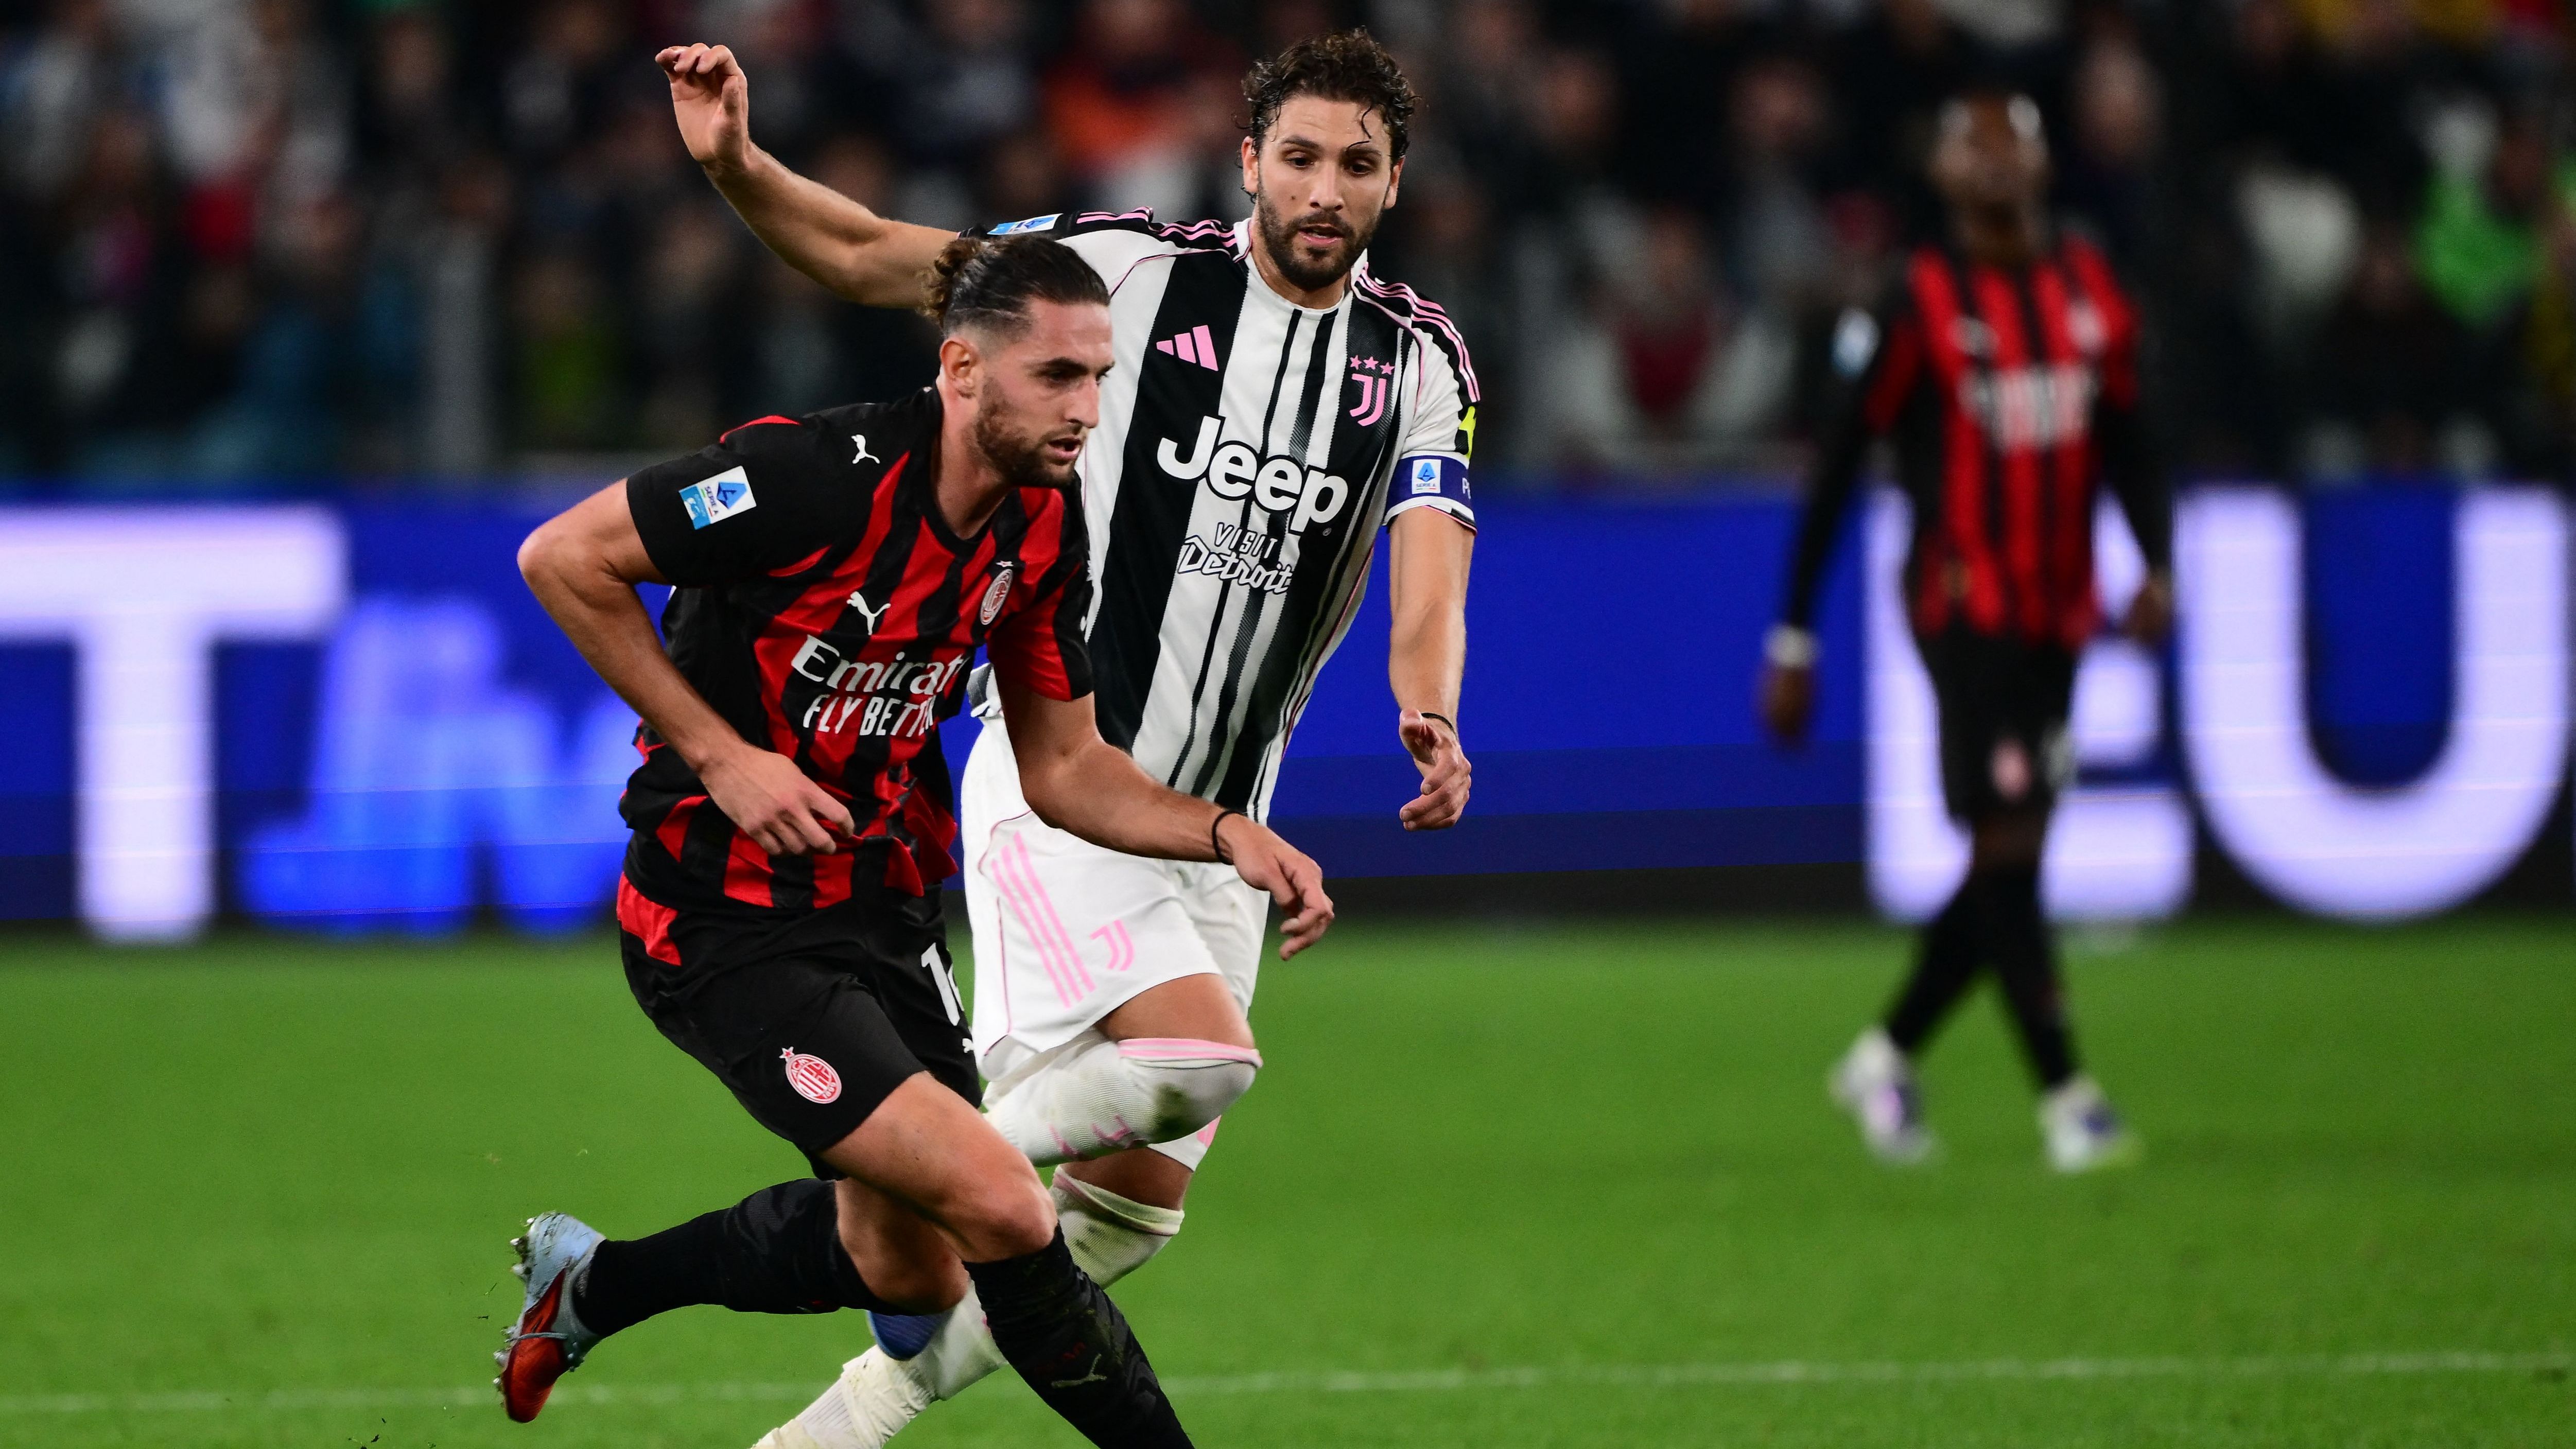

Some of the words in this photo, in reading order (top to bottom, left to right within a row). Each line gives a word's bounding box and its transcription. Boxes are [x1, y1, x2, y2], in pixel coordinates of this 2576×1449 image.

[705, 486, 717, 506] SERIE
[1157, 416, 1348, 532] Jeep
[1177, 534, 1293, 595] Detroit
[1215, 522, 1278, 560] VISIT
[791, 634, 970, 695] Emirat
[803, 694, 863, 734] FLY
